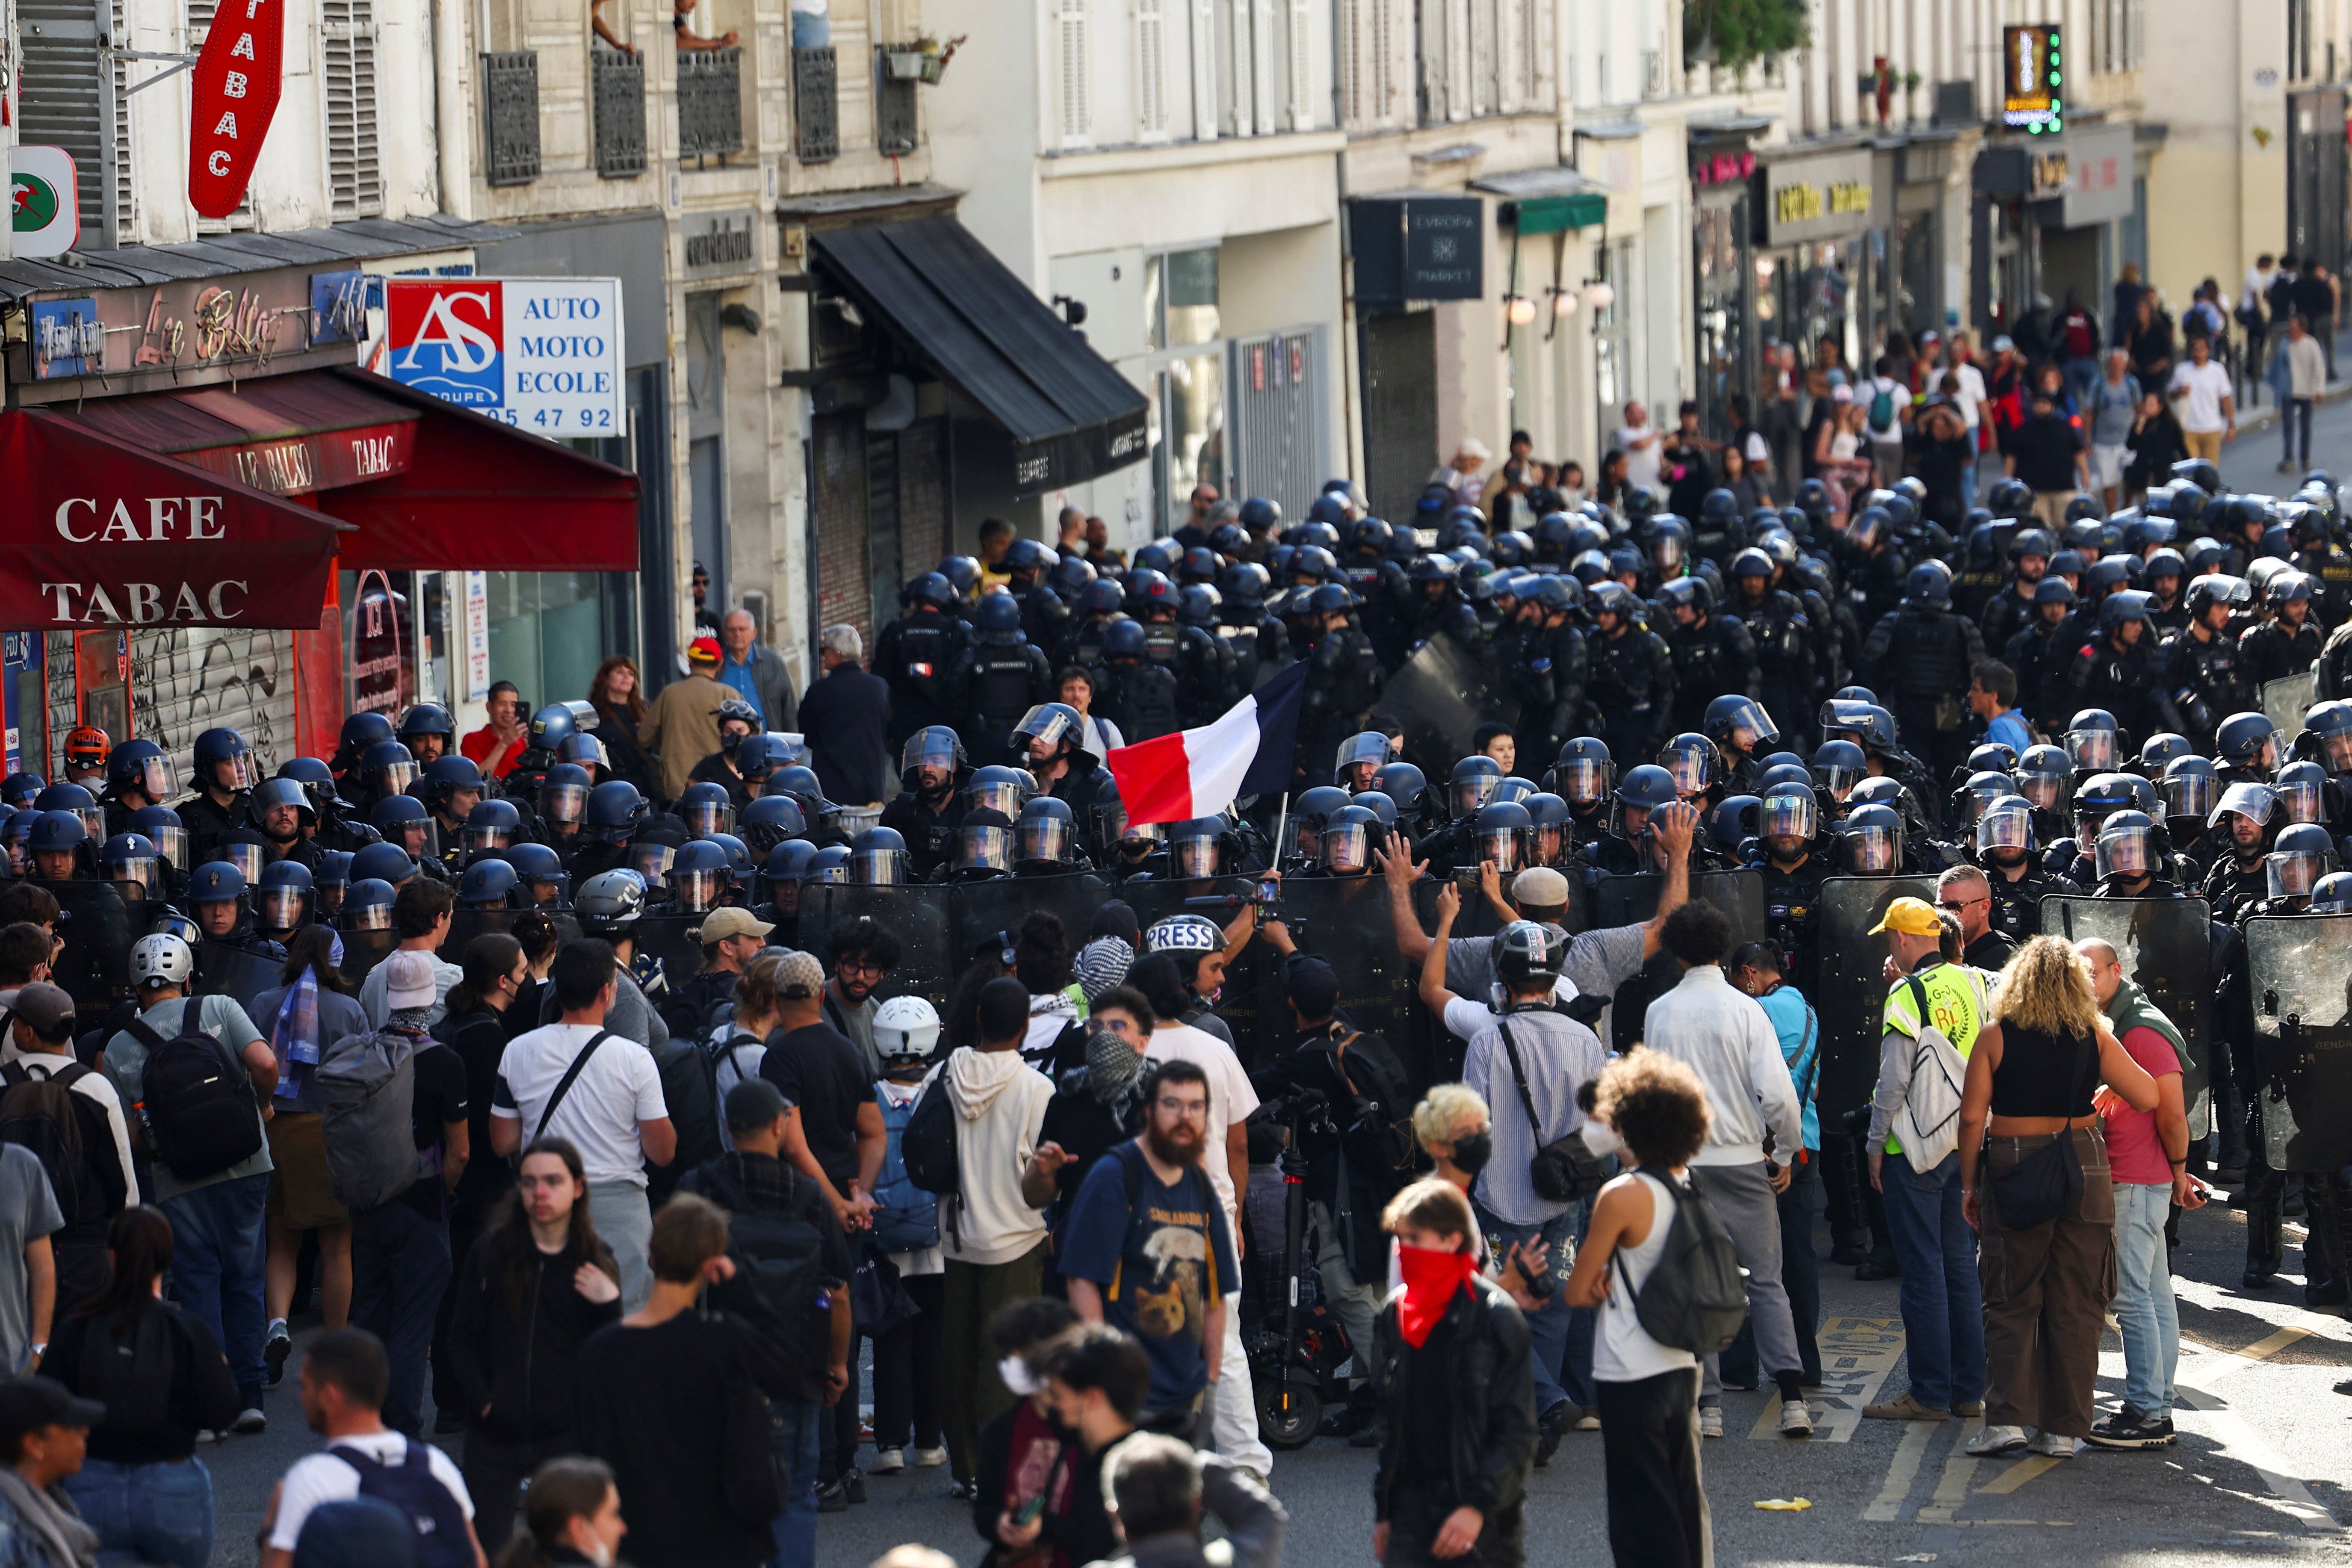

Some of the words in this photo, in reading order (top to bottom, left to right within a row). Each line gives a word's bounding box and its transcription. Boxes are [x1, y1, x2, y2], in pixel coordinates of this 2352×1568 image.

[208, 0, 265, 177] TABAC
[524, 297, 601, 320] AUTO
[396, 291, 497, 373] AS
[520, 336, 605, 358] MOTO
[434, 392, 485, 403] ROUPE
[517, 372, 611, 394] ECOLE
[535, 409, 564, 427] 47
[581, 409, 611, 427] 92
[265, 443, 313, 491] BALTO
[351, 435, 394, 476] TABAC
[56, 496, 226, 543] CAFE
[42, 580, 249, 624] TABAC
[366, 599, 383, 638] ICI
[6, 635, 18, 658] FDJ
[74, 733, 103, 744] PHOTO
[1148, 924, 1213, 951] PRESS
[149, 938, 163, 973] MEDIA
